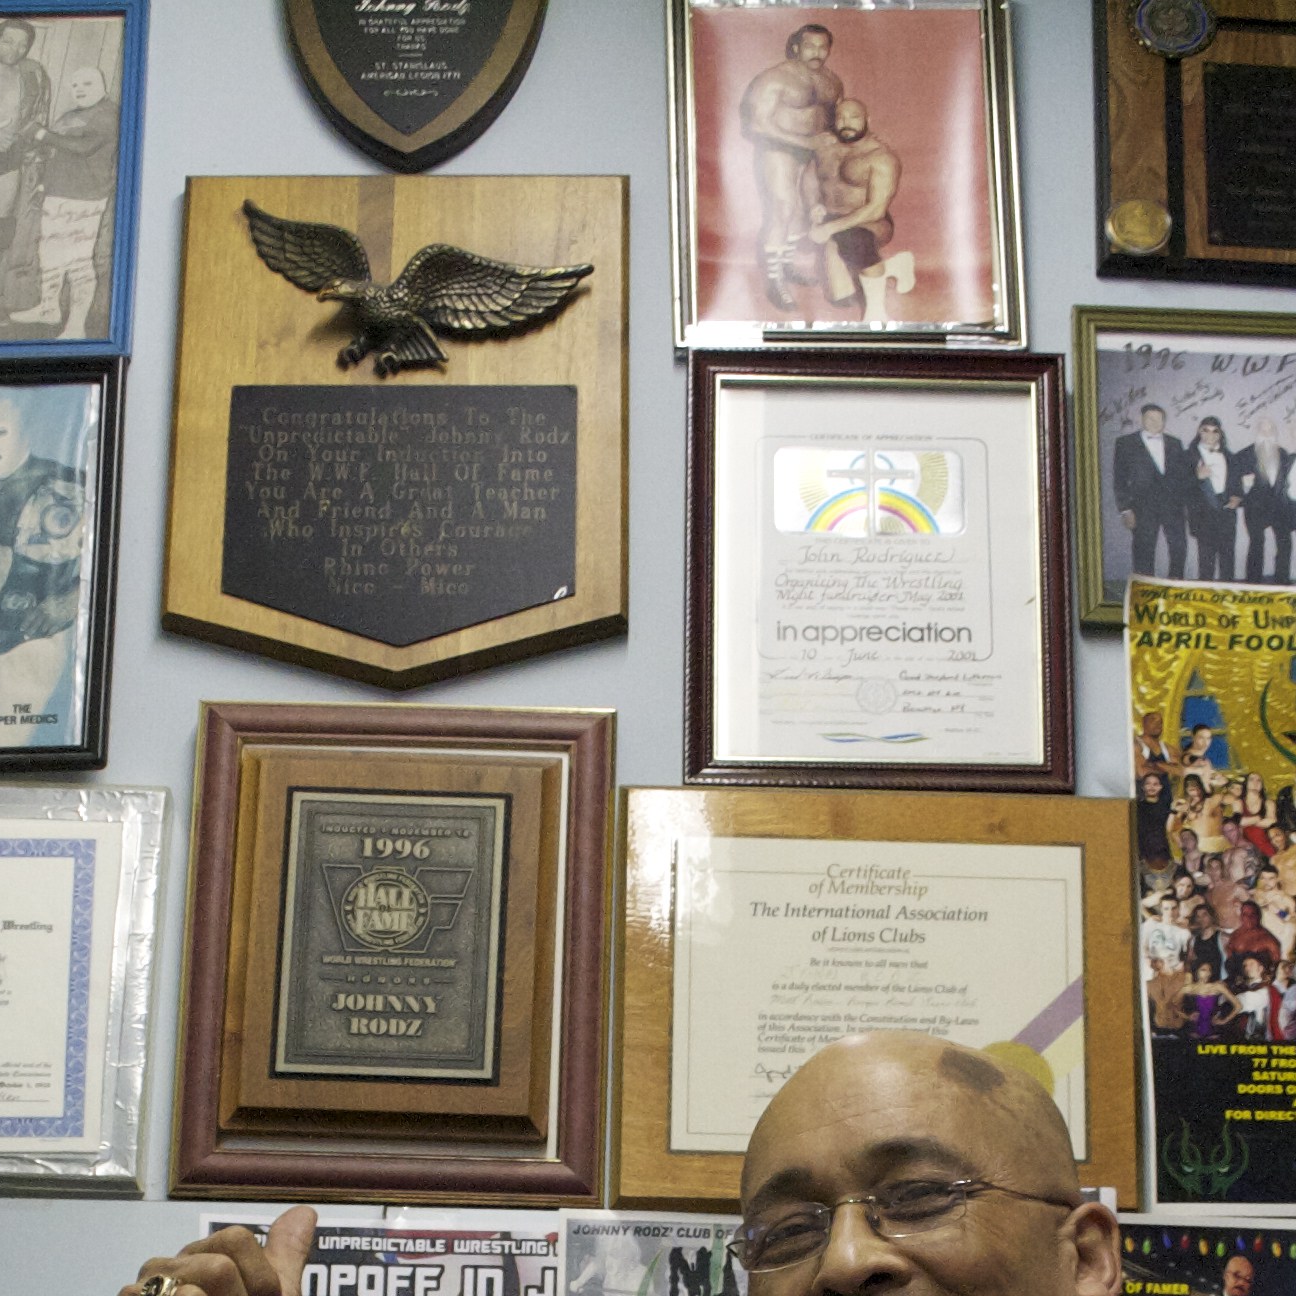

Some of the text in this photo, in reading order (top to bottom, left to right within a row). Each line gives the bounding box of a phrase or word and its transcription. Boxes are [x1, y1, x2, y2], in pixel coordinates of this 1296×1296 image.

[776, 620, 973, 648] in appreciation
[1136, 629, 1219, 651] APRIL
[362, 837, 432, 860] 1996
[826, 863, 912, 880] Certificate
[808, 877, 929, 901] of Membership
[355, 910, 417, 935] FAME
[750, 901, 989, 923] The International Association
[812, 925, 927, 944] of Lions Clubs
[330, 992, 439, 1015] JOHNNY
[349, 1016, 423, 1037] RODZ
[572, 1224, 631, 1238] JOHNNY
[676, 1226, 711, 1239] CLUB
[714, 1227, 734, 1240] OF
[318, 1236, 550, 1256] UNPREDICTABLE WRESTLING
